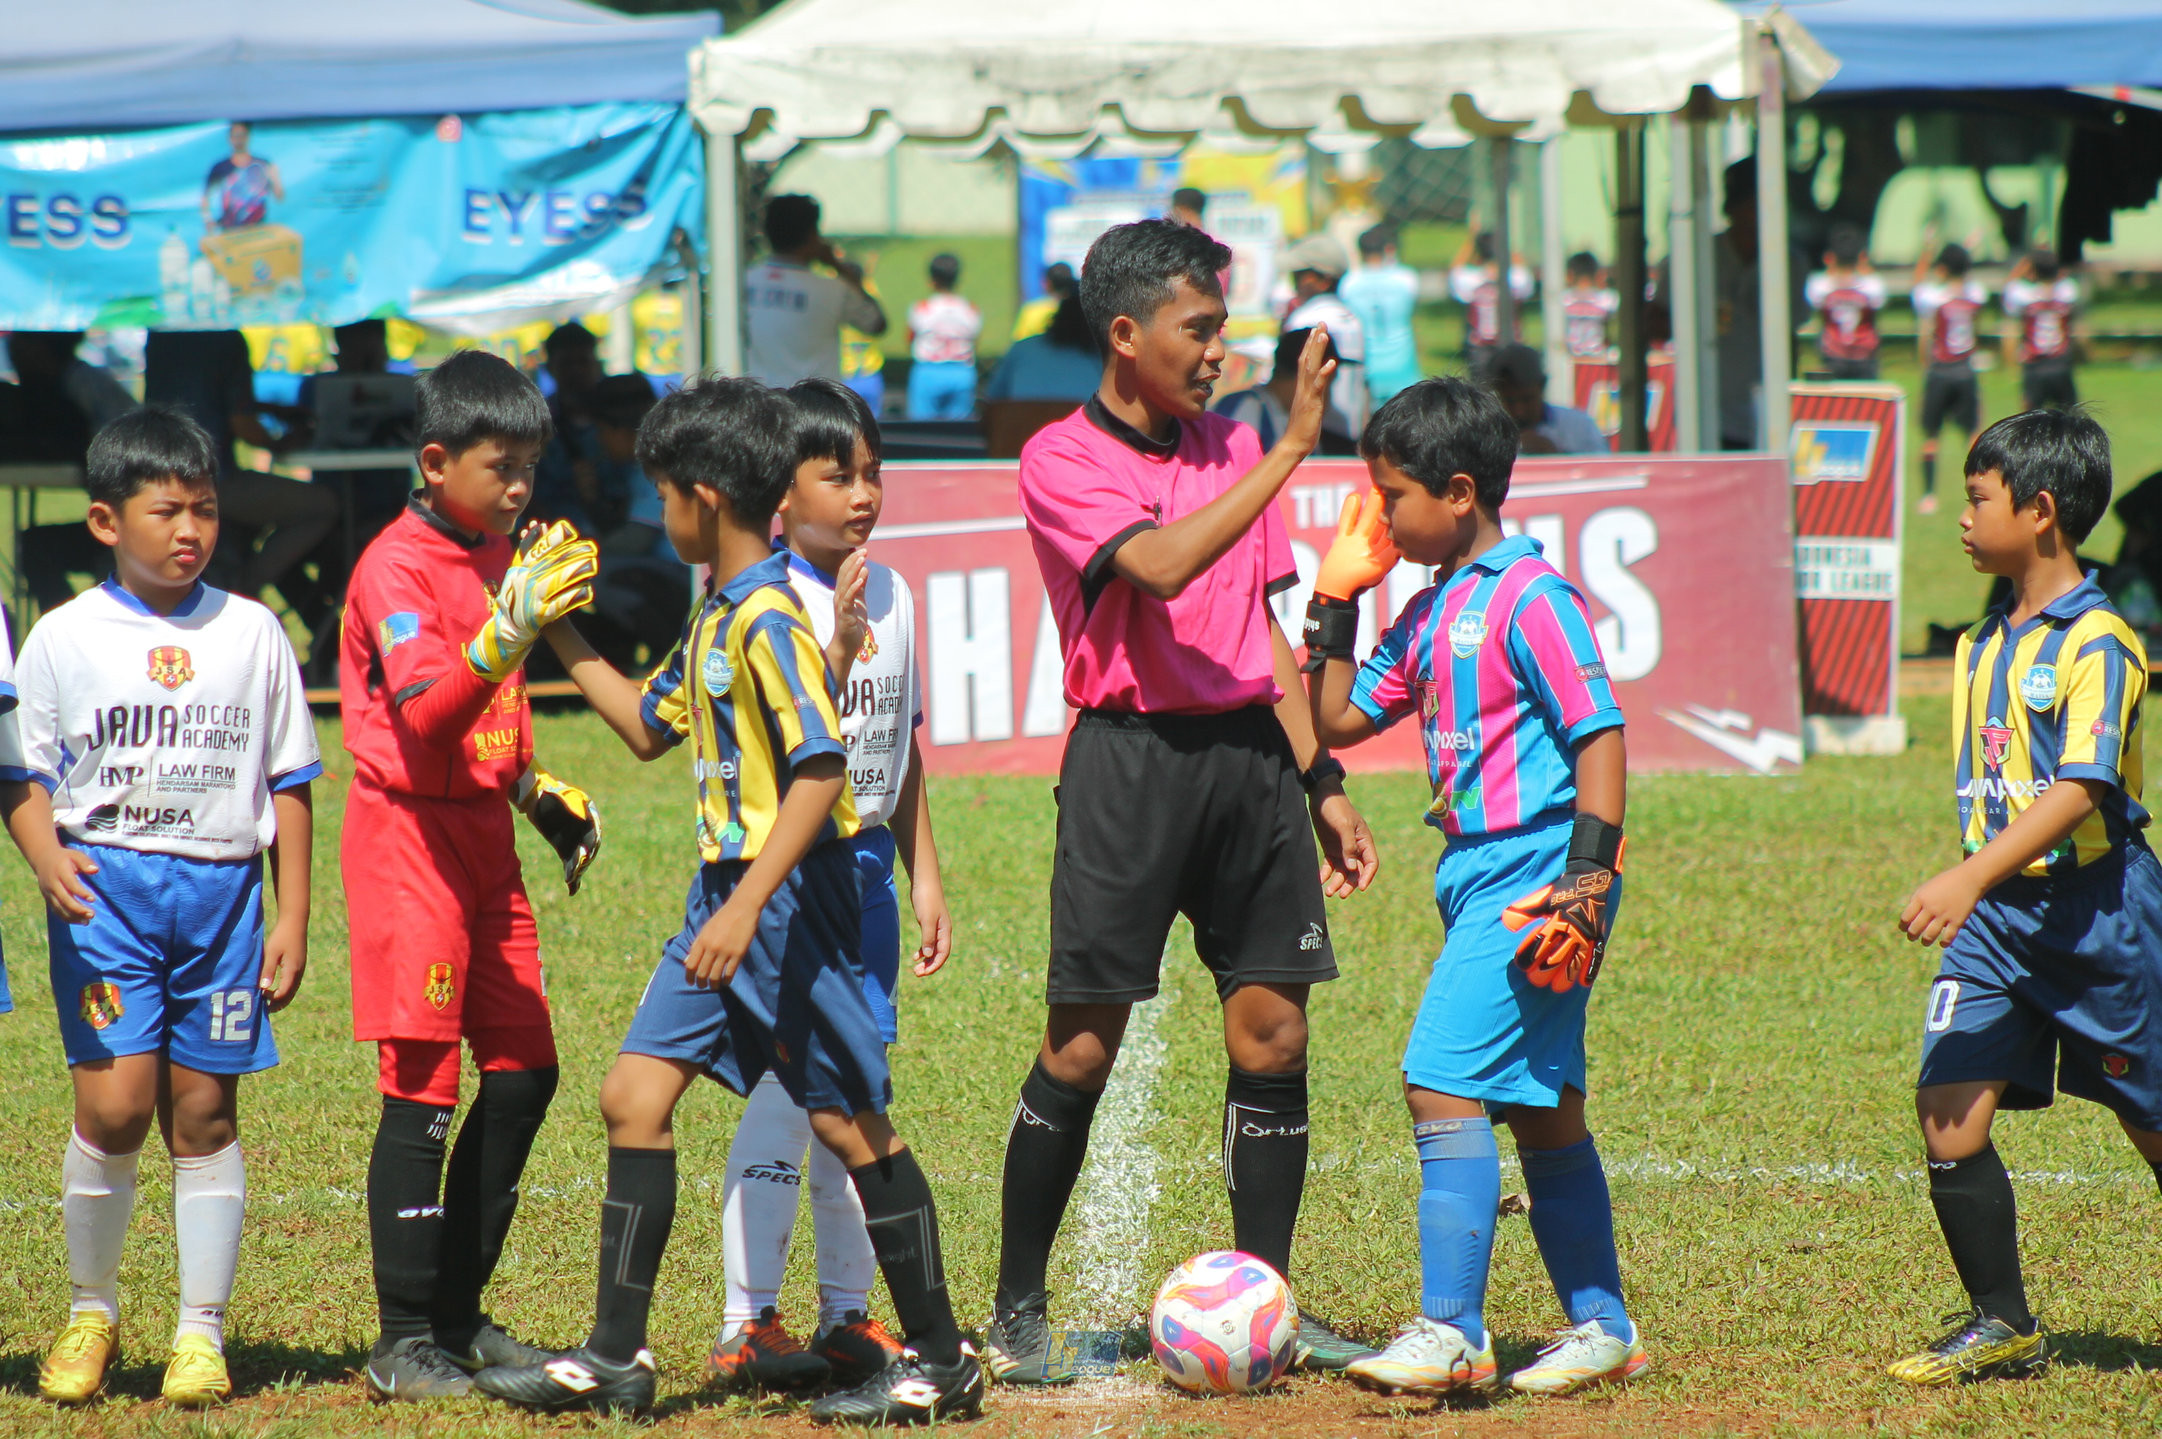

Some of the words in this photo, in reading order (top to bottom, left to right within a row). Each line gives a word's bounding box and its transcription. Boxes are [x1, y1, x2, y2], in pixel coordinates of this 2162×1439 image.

[8, 194, 132, 250] ESS
[87, 705, 178, 751] JAVA
[184, 704, 250, 729] SOCCER
[487, 728, 519, 748] NUS
[864, 730, 886, 743] LAW
[182, 729, 249, 752] ACADEMY
[158, 764, 198, 778] LAW
[202, 765, 236, 781] FIRM
[125, 805, 194, 826] NUSA
[122, 823, 149, 832] FLOAT
[151, 826, 195, 835] SOLUTION
[210, 991, 251, 1041] 12
[1927, 980, 1960, 1032] 0
[742, 1168, 801, 1186] SPECS
